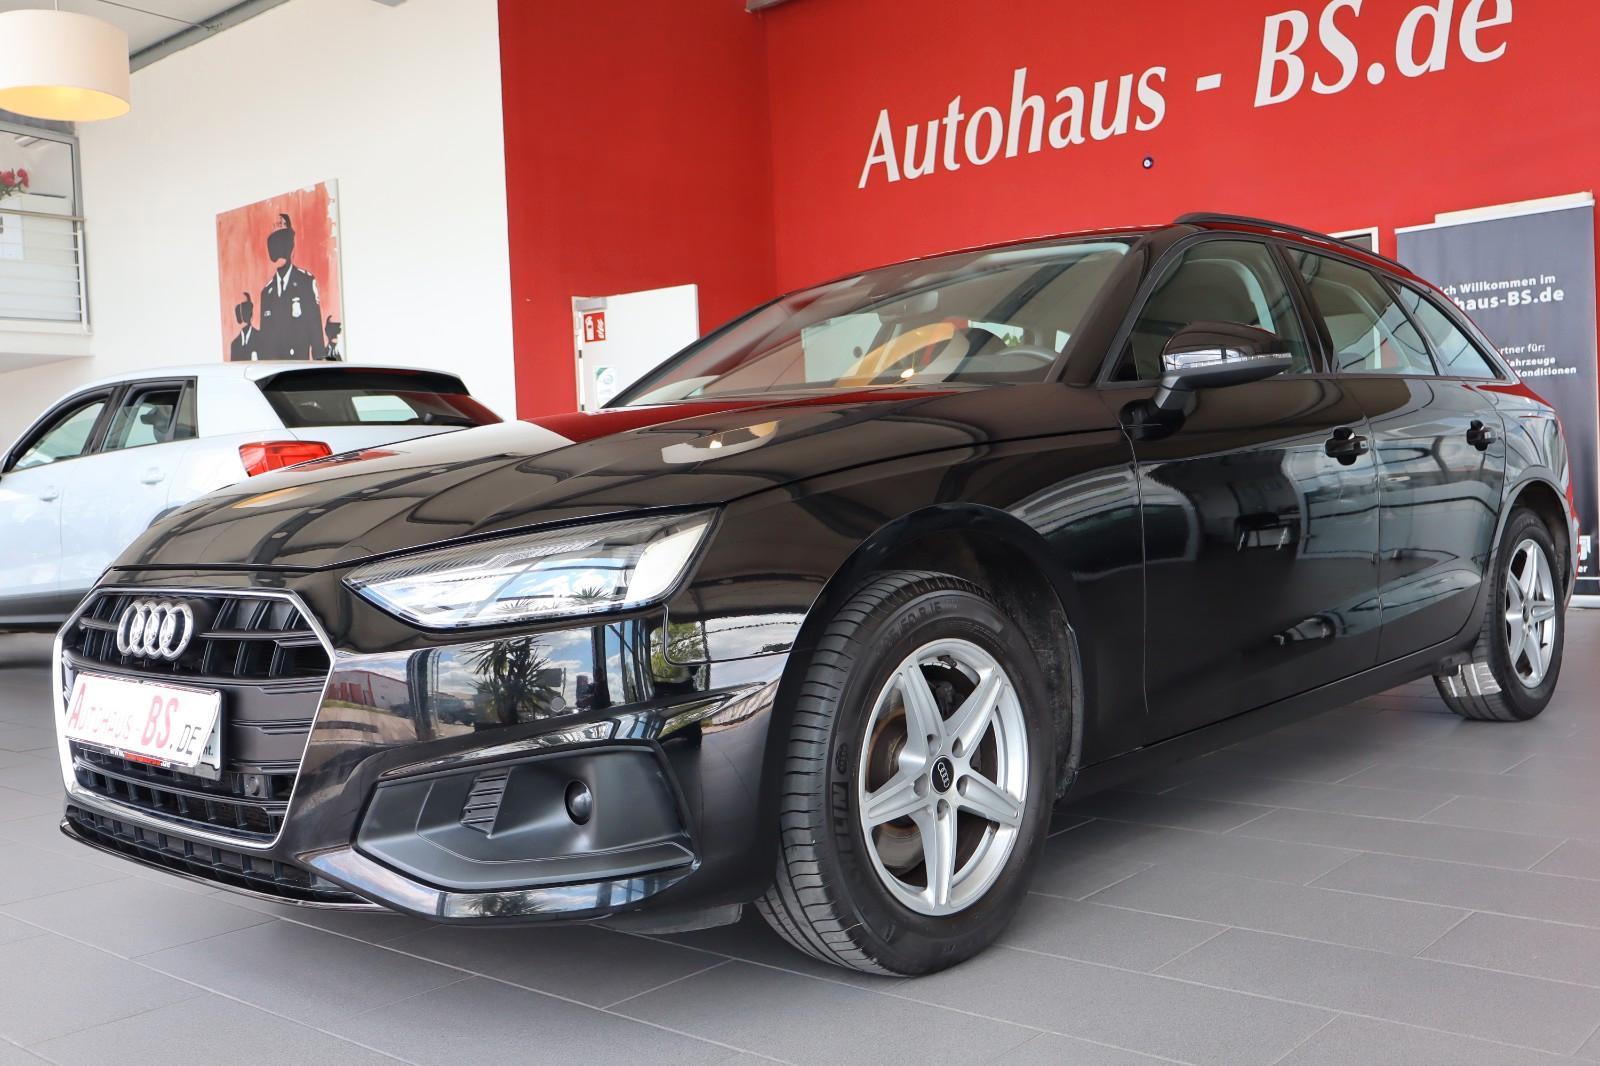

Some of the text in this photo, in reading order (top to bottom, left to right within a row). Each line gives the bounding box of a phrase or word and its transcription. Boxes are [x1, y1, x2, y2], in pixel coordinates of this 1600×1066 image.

[859, 0, 1513, 189] Autohaus - BS.de
[1460, 277, 1537, 293] Willkommen
[1540, 274, 1556, 285] im
[1454, 287, 1564, 311] haus-BS.de
[1498, 343, 1546, 354] rtner für:
[1507, 356, 1556, 367] ahrzeuge
[1515, 366, 1577, 378] Konditionen
